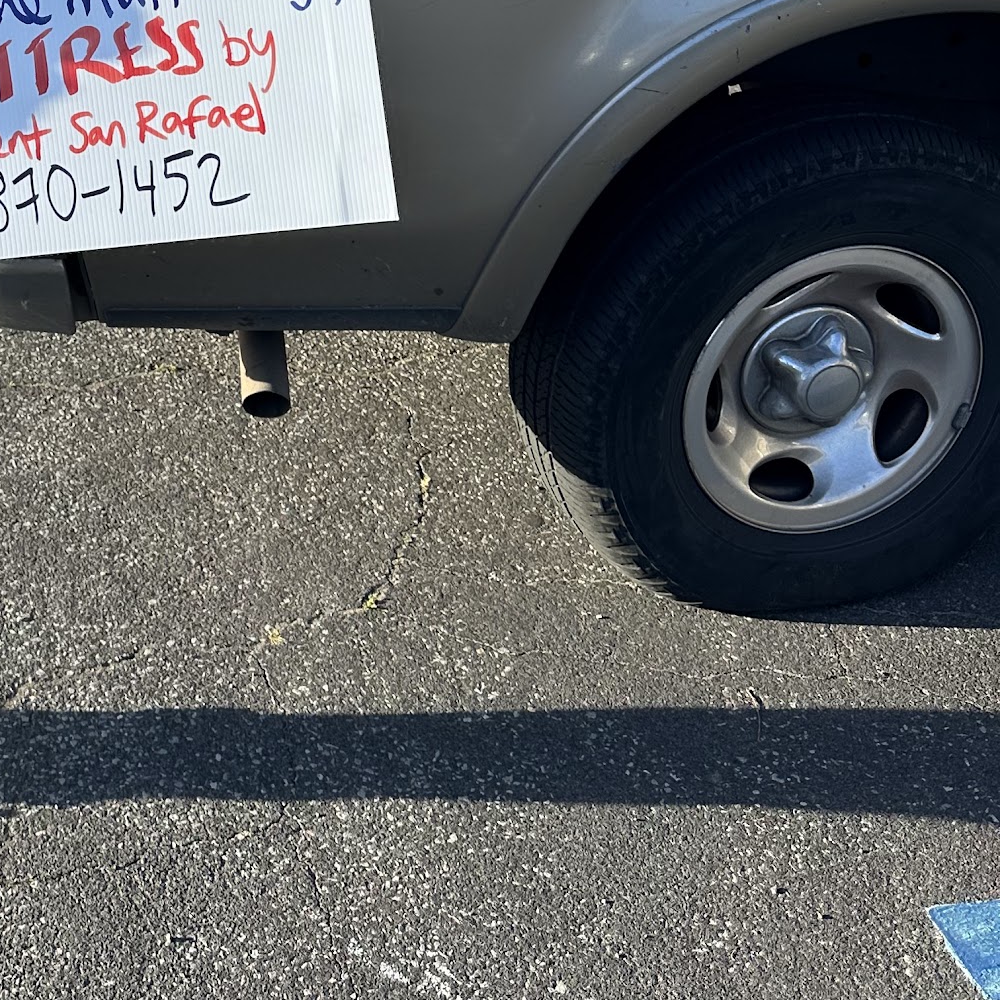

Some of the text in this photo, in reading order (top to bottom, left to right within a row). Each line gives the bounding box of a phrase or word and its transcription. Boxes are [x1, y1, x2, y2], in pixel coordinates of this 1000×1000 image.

[222, 19, 276, 93] by
[69, 111, 126, 154] San
[136, 82, 267, 148] Rafael
